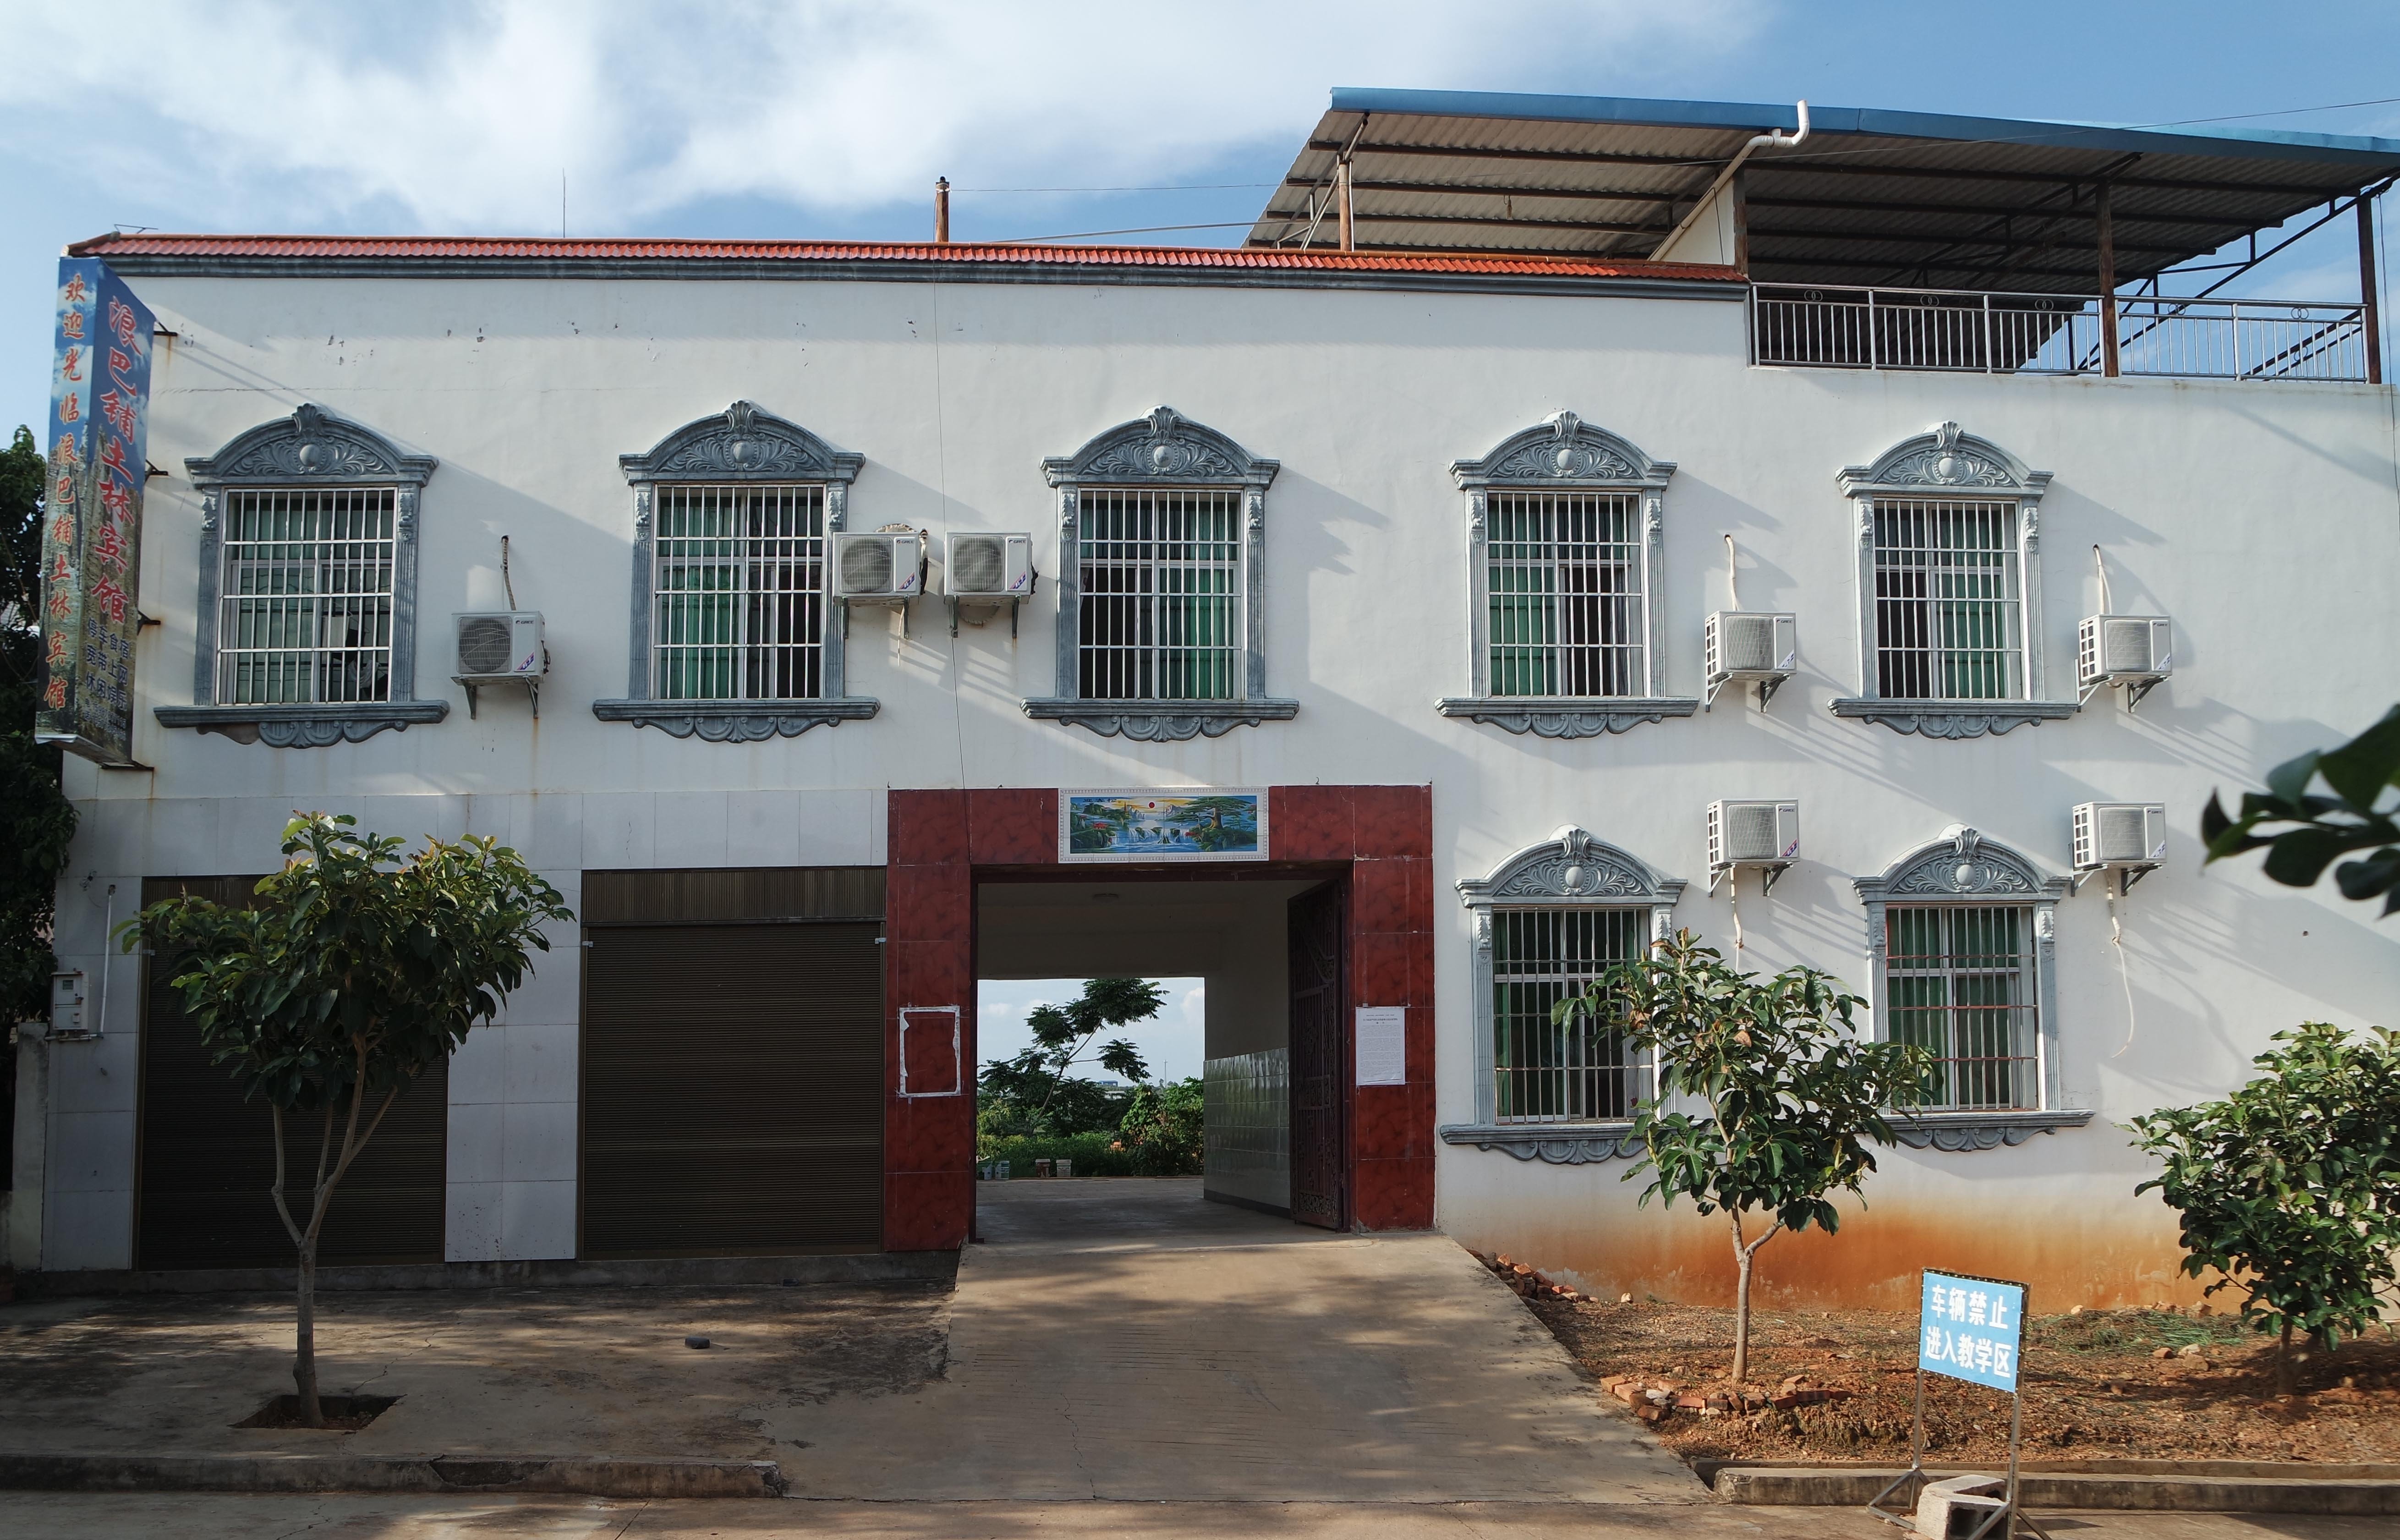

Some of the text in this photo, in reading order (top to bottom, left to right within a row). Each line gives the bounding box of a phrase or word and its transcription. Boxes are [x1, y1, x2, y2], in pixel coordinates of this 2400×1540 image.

[44, 274, 86, 710] 欢迎光临浪巴铺土林宾馆
[92, 296, 142, 624] 浪巴铺土林宾馆
[1925, 1326, 2011, 1378] 进入教学区
[1931, 1284, 2008, 1330] 车辆禁止
